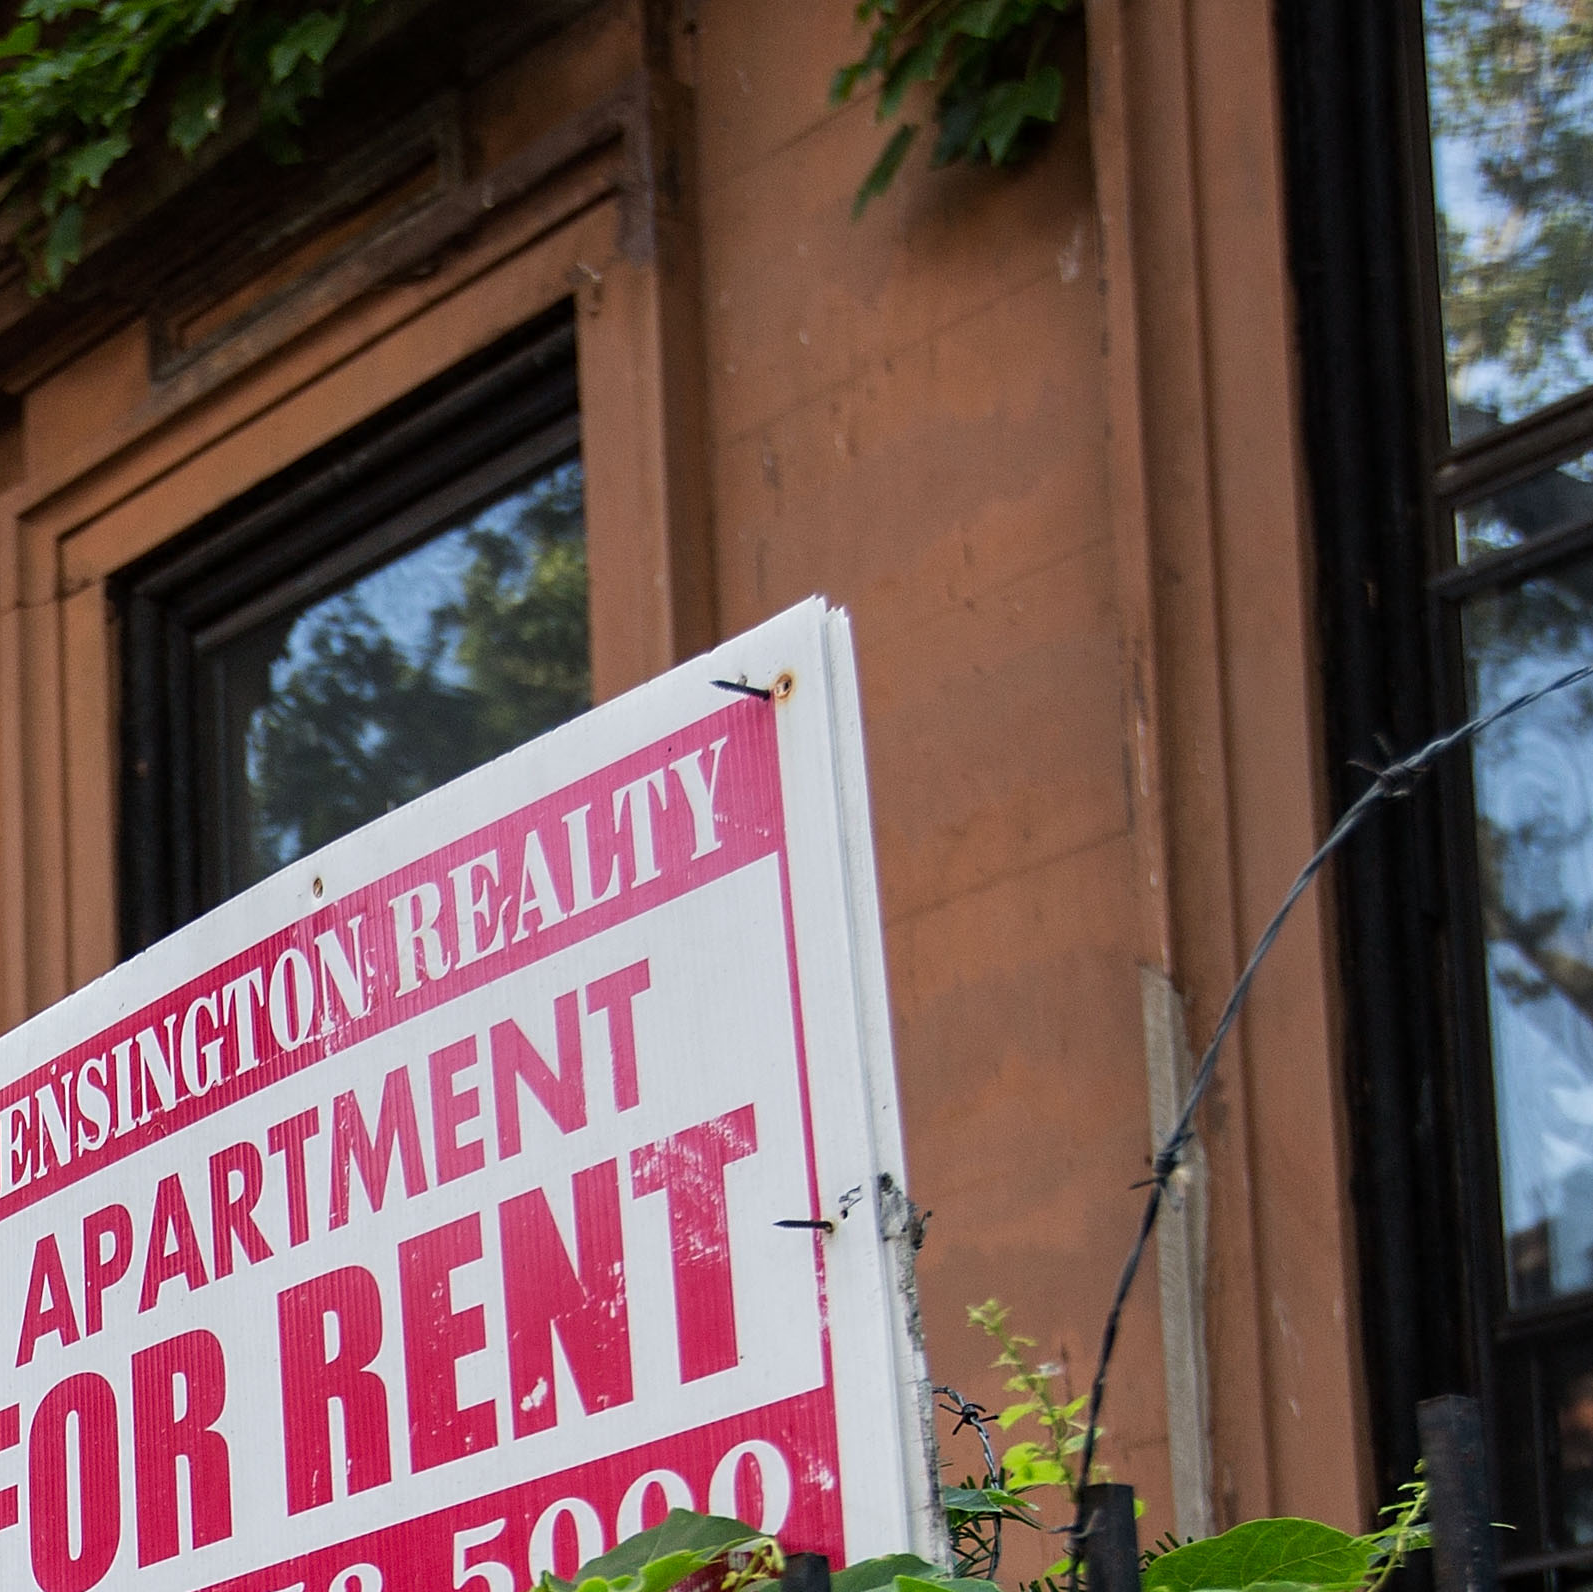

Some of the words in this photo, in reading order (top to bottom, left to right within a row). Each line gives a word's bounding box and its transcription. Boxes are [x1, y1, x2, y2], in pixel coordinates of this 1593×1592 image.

[388, 736, 728, 997] REALTY
[15, 958, 651, 1368] APARTMENT
[277, 1103, 758, 1517] RENT
